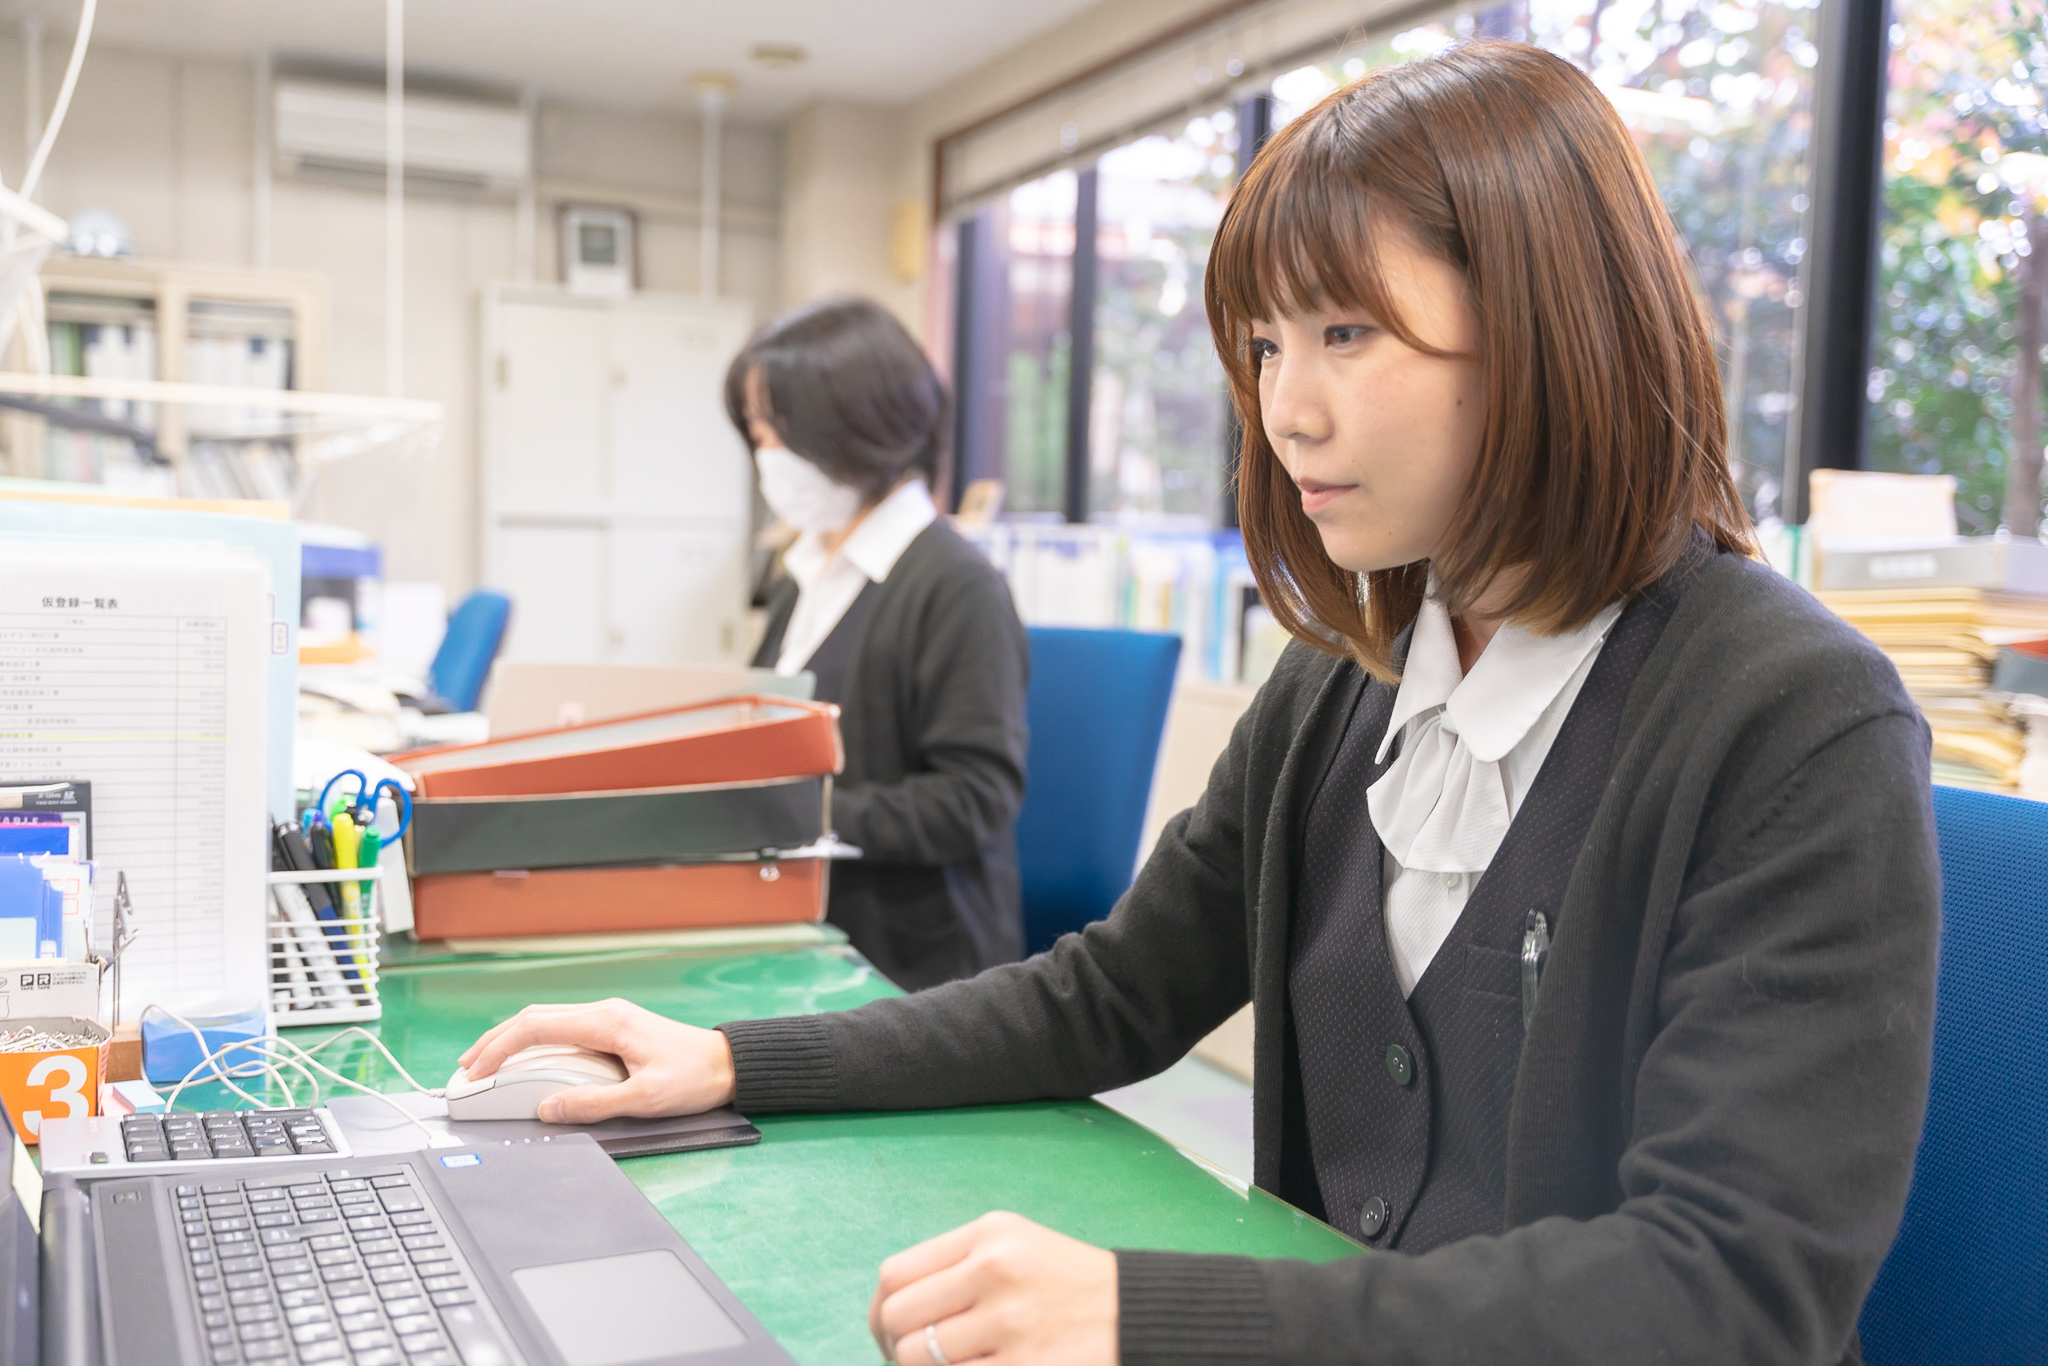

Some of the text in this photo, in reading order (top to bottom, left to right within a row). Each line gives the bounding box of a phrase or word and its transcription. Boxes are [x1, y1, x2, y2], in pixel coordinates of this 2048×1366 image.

[42, 597, 119, 609] 仮登録一覧表
[0, 816, 39, 824] ABLE
[38, 974, 50, 985] R
[23, 1054, 89, 1136] 3
